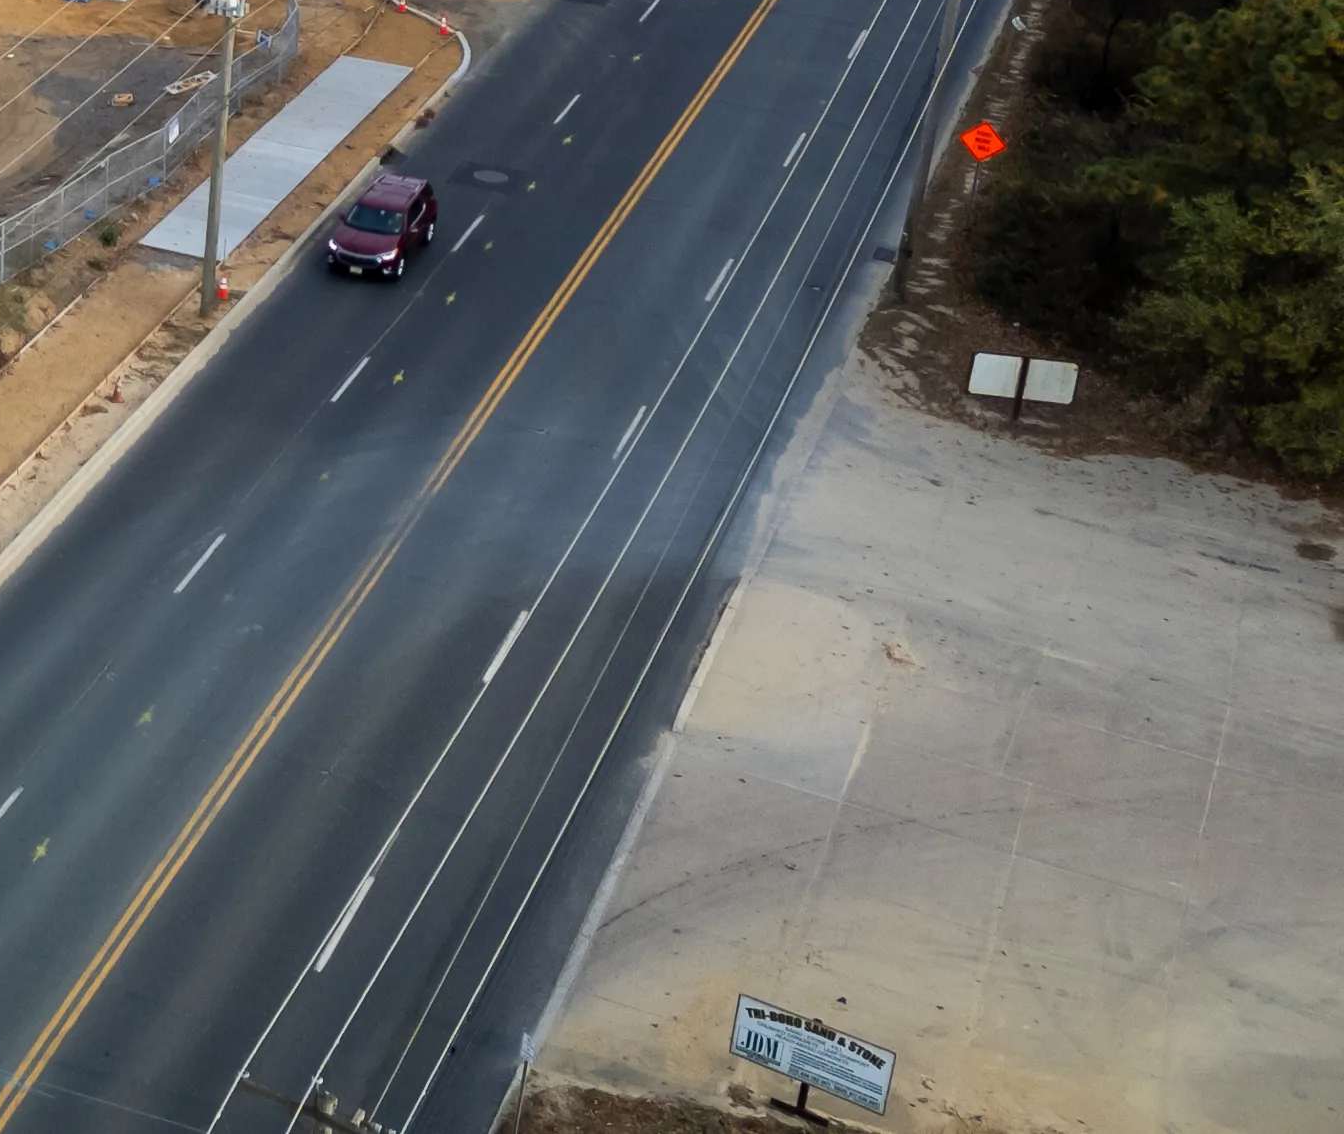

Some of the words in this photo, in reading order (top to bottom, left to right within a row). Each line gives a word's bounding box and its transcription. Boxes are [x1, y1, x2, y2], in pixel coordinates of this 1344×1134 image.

[741, 1030, 779, 1060] JDM
[745, 1007, 802, 1028] TRI-BORO
[804, 1020, 837, 1042] SAND
[837, 1037, 846, 1047] &
[848, 1041, 886, 1070] STONE
